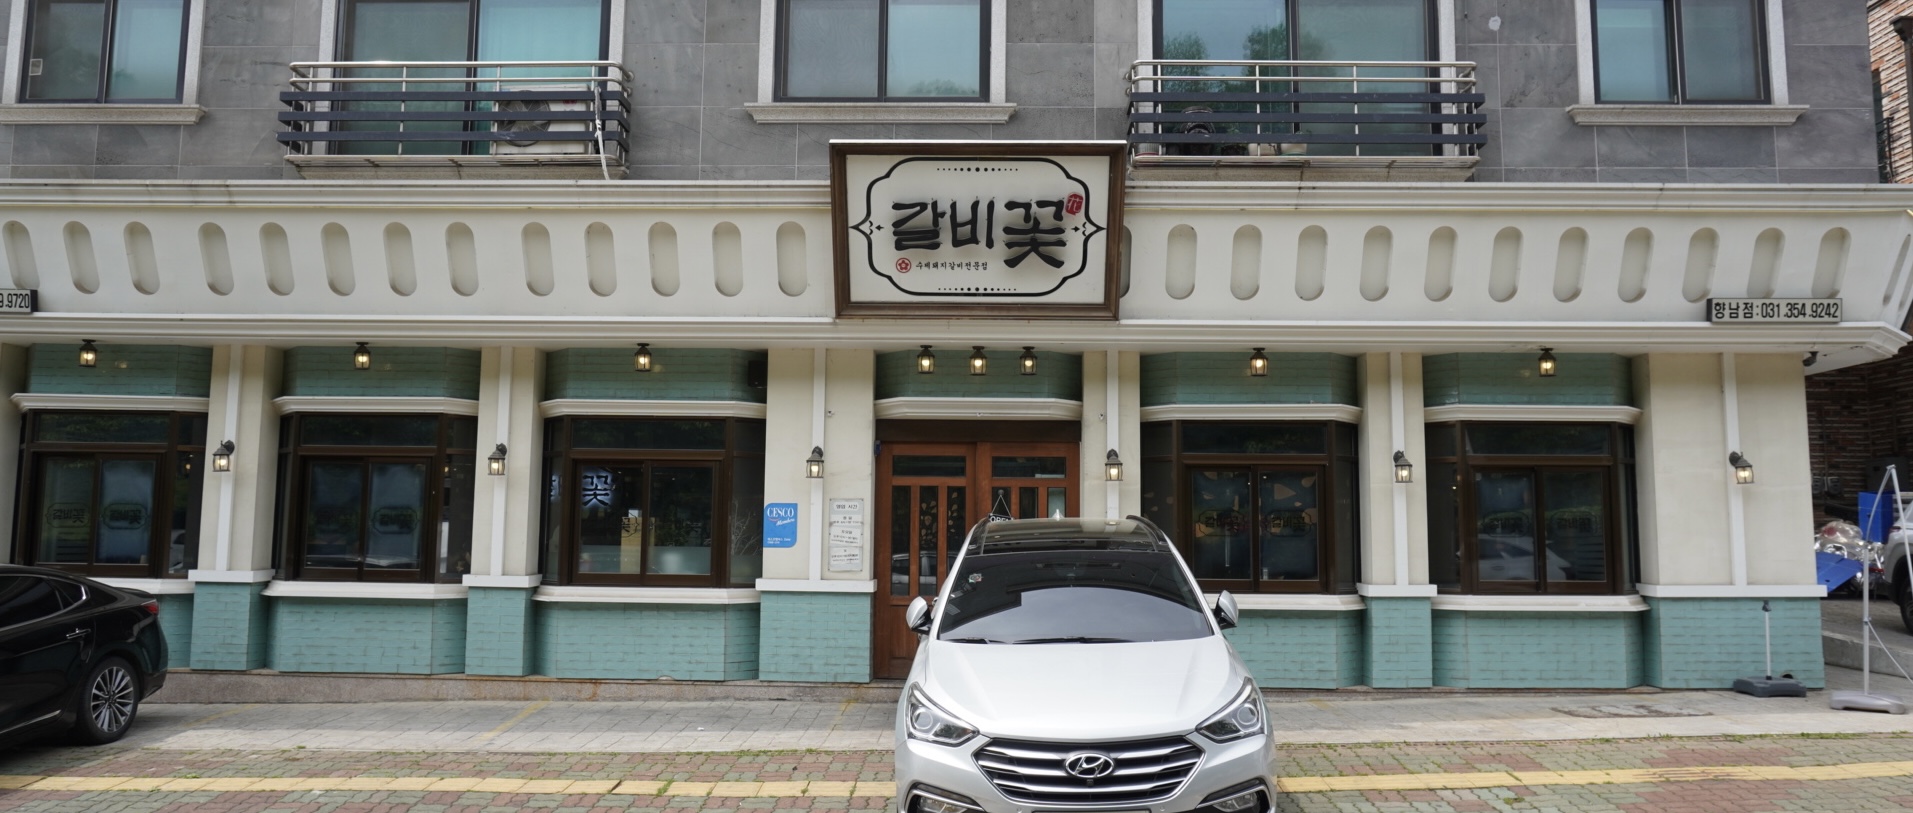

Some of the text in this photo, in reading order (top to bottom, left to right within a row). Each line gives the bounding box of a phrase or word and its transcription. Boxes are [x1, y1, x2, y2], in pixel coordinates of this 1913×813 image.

[891, 199, 1067, 269] 갈비꽃
[916, 261, 988, 271] 수제돼지갈비전문점
[767, 507, 795, 518] CESCO
